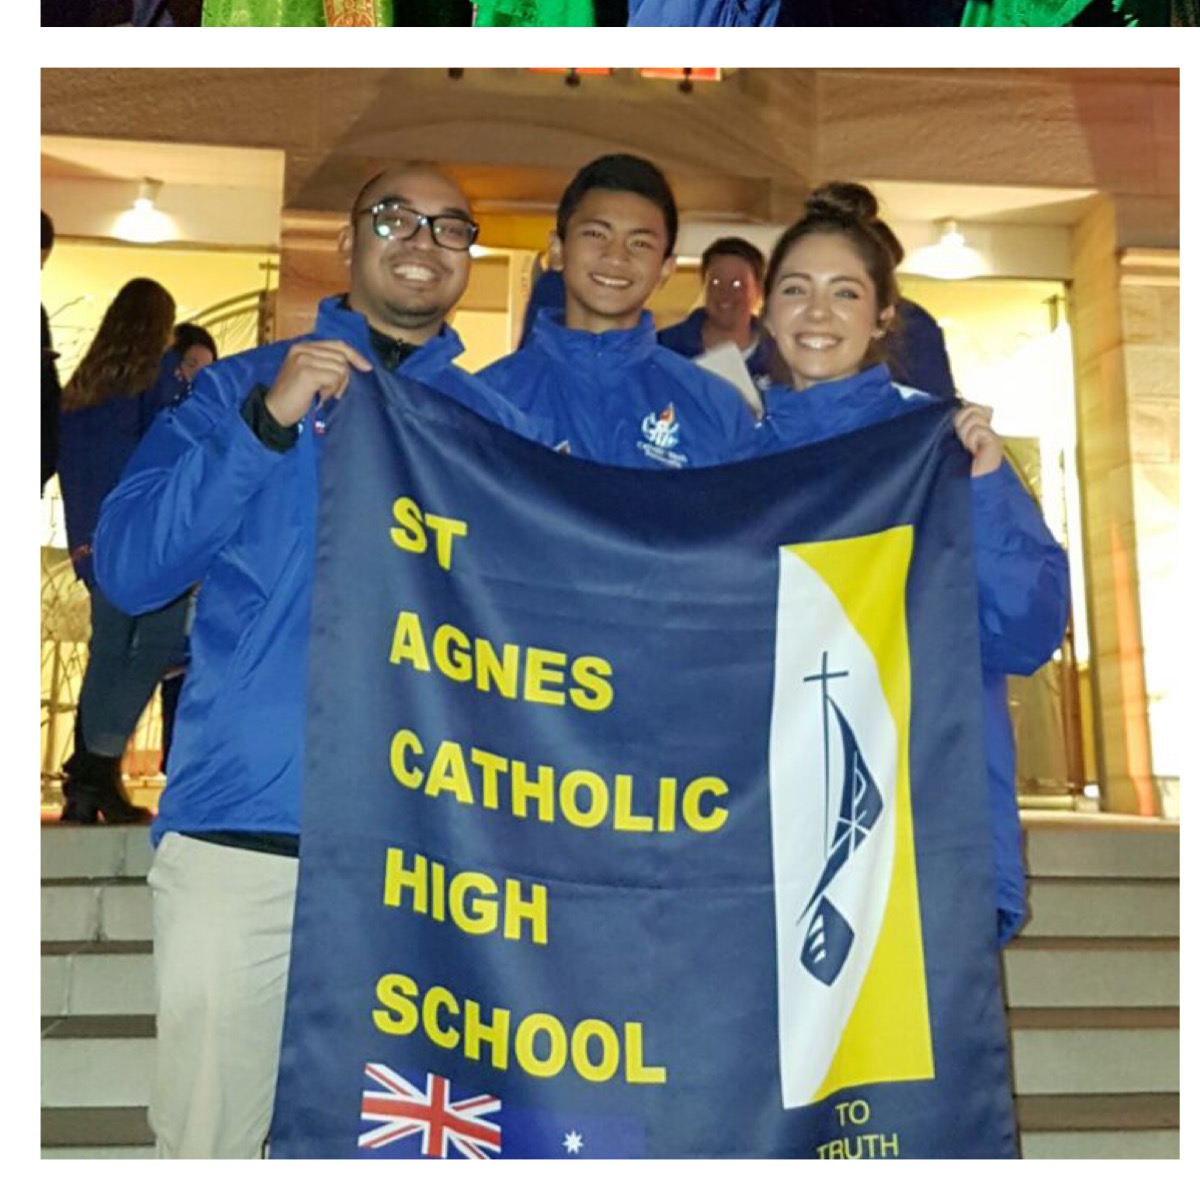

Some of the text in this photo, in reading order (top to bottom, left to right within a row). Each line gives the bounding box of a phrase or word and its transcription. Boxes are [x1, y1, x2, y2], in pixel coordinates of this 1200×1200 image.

[389, 496, 468, 570] ST
[389, 611, 614, 711] AGNES
[389, 729, 730, 833] CATHOLIC
[383, 848, 549, 946] HIGH
[372, 974, 667, 1084] SCHOOL
[815, 1132, 900, 1159] TRUTH
[834, 1099, 871, 1127] TO
